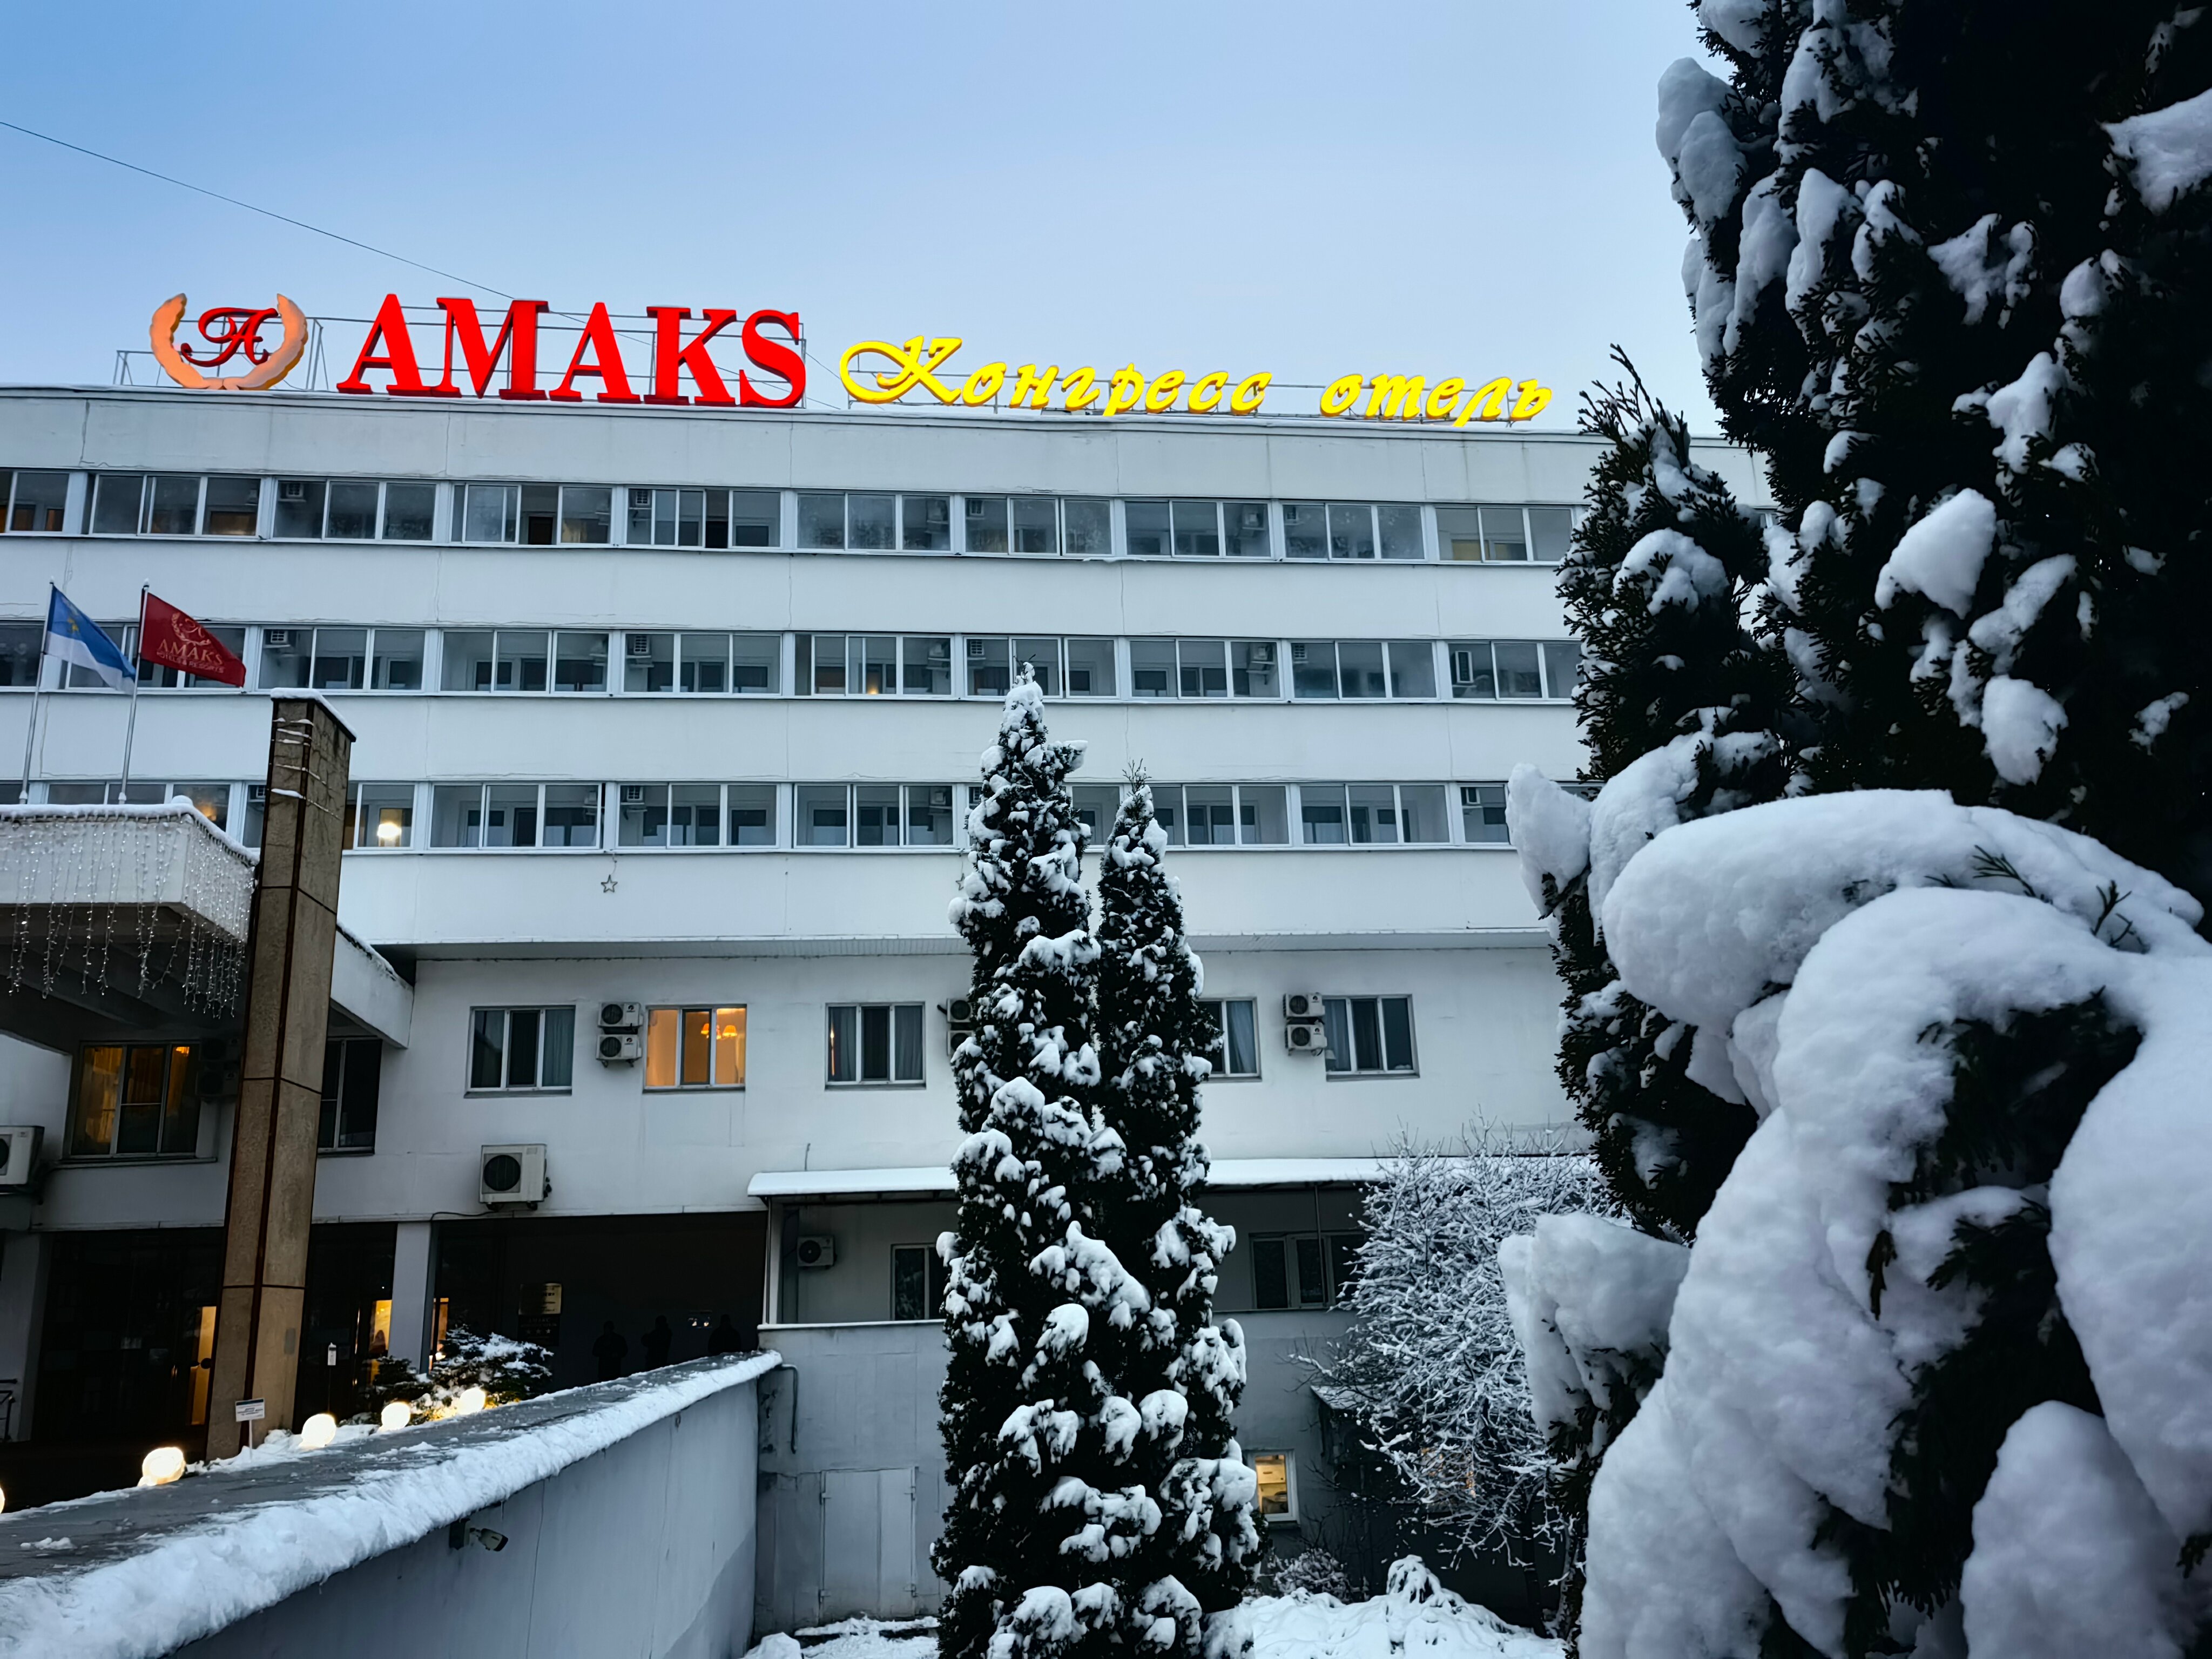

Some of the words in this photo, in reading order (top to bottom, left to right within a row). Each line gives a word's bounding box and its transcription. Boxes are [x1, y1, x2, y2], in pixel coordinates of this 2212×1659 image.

[336, 294, 806, 408] AMAKS
[840, 335, 1272, 417] Конгресс
[1320, 374, 1553, 428] отель
[157, 639, 223, 665] AMAKS
